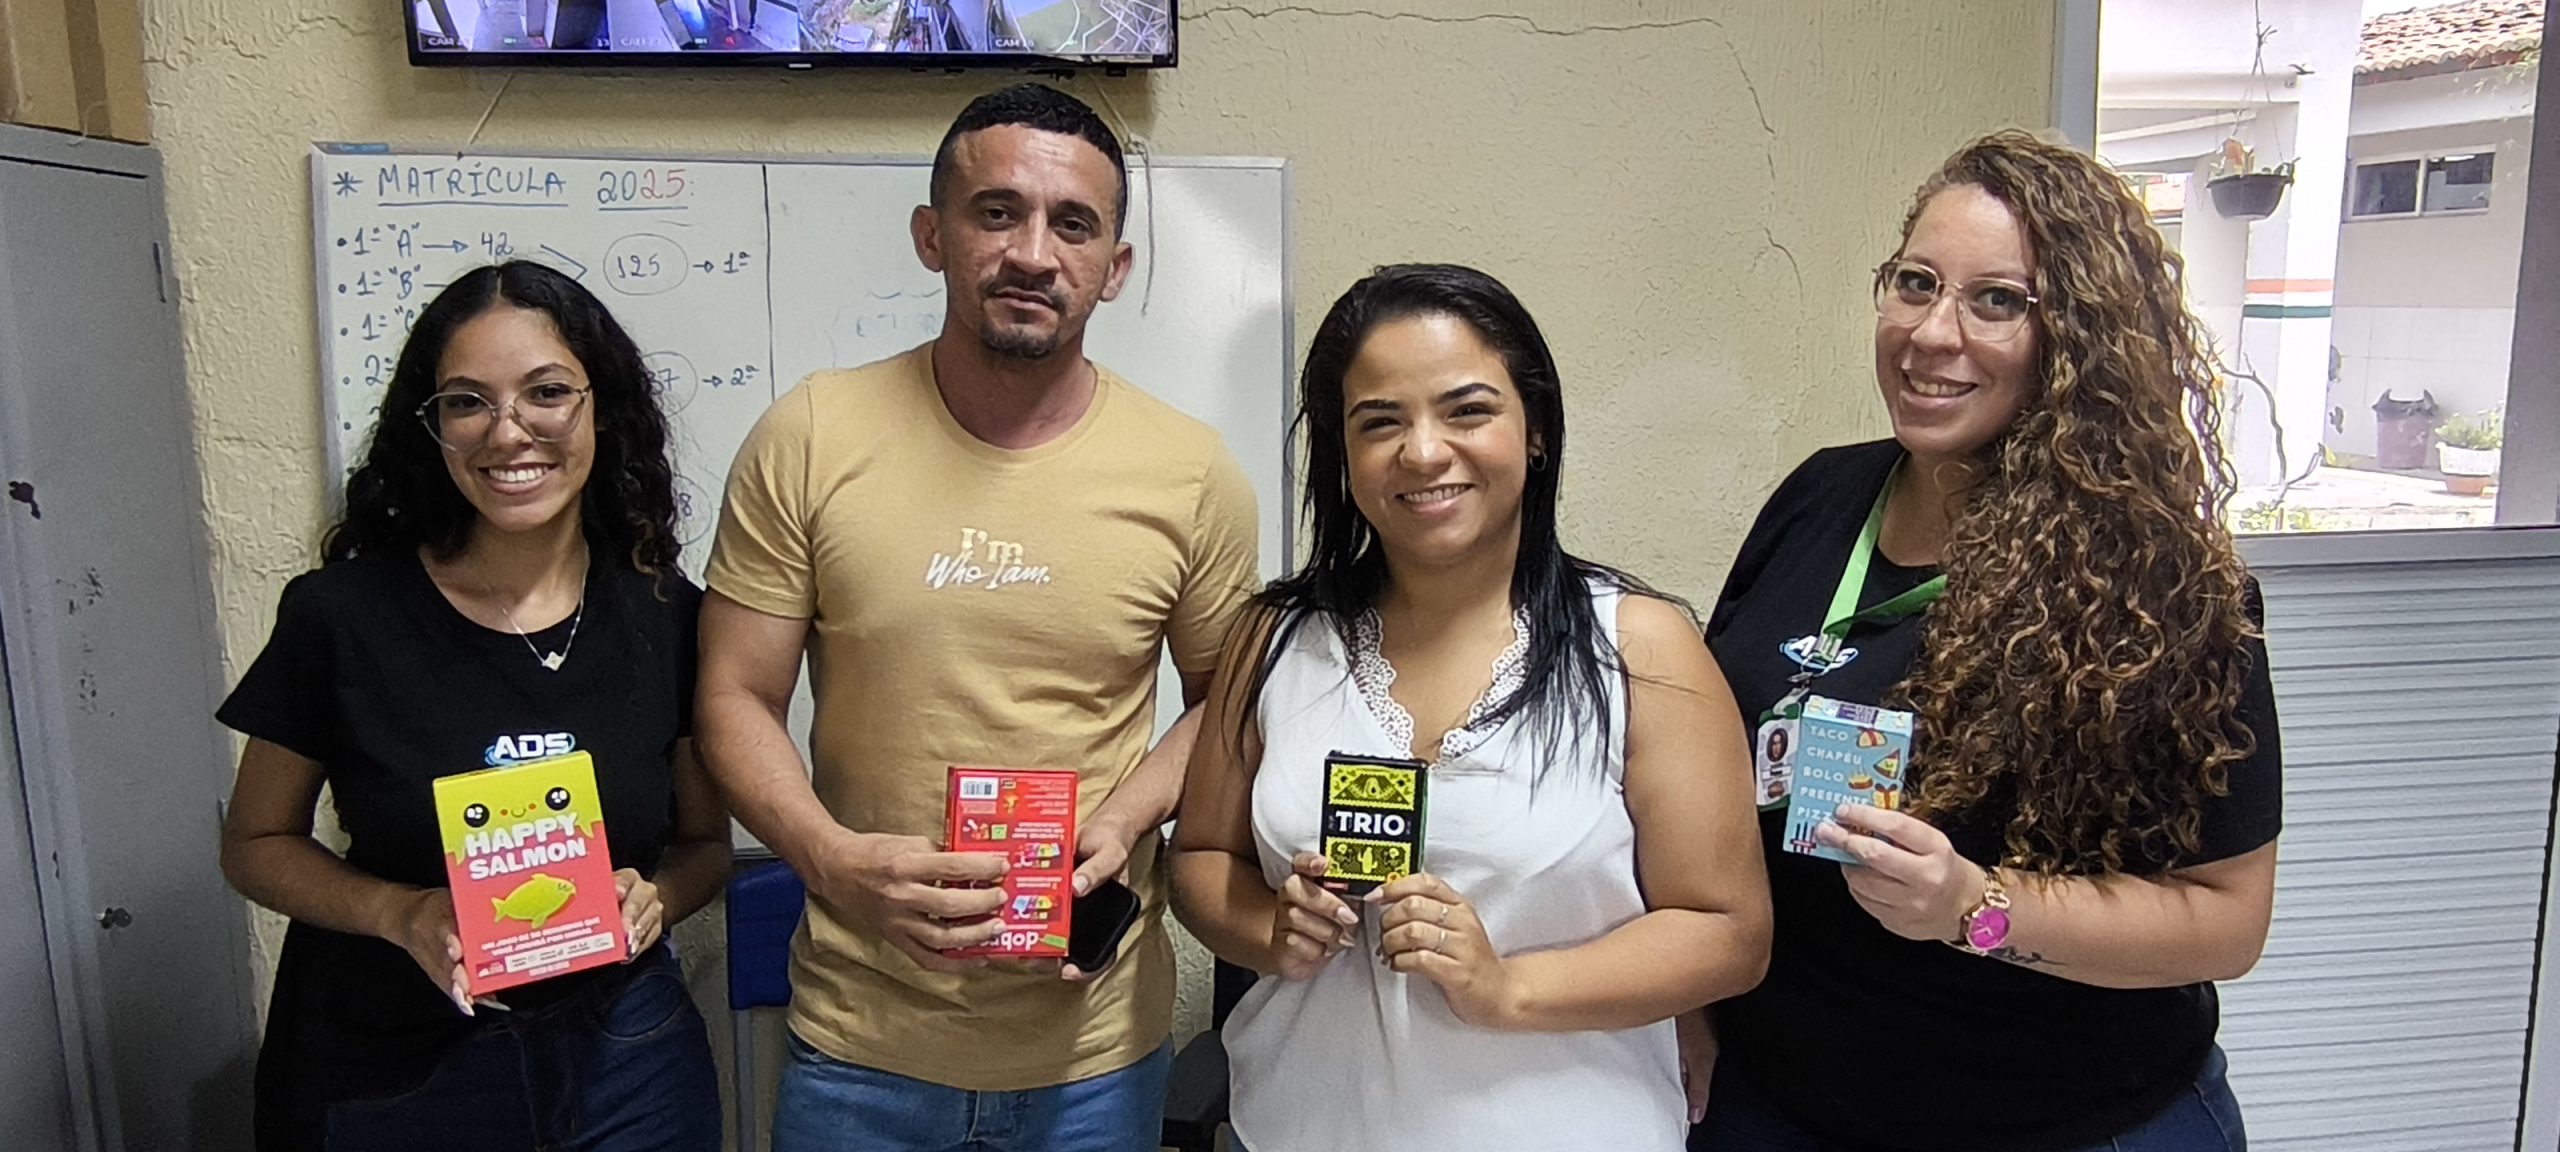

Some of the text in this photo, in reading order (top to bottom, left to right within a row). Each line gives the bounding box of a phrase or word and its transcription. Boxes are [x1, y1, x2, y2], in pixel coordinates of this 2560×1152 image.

[378, 161, 567, 198] MATRÍCULA
[481, 231, 514, 257] 42
[616, 252, 660, 279] 125
[493, 732, 569, 760] ADS
[1810, 725, 1849, 741] TACO
[1803, 765, 1845, 782] BOLO
[1799, 786, 1869, 805] PRESENTE
[465, 812, 579, 857] HAPPY
[1335, 810, 1406, 836] TRIO
[468, 837, 588, 880] SALMON
